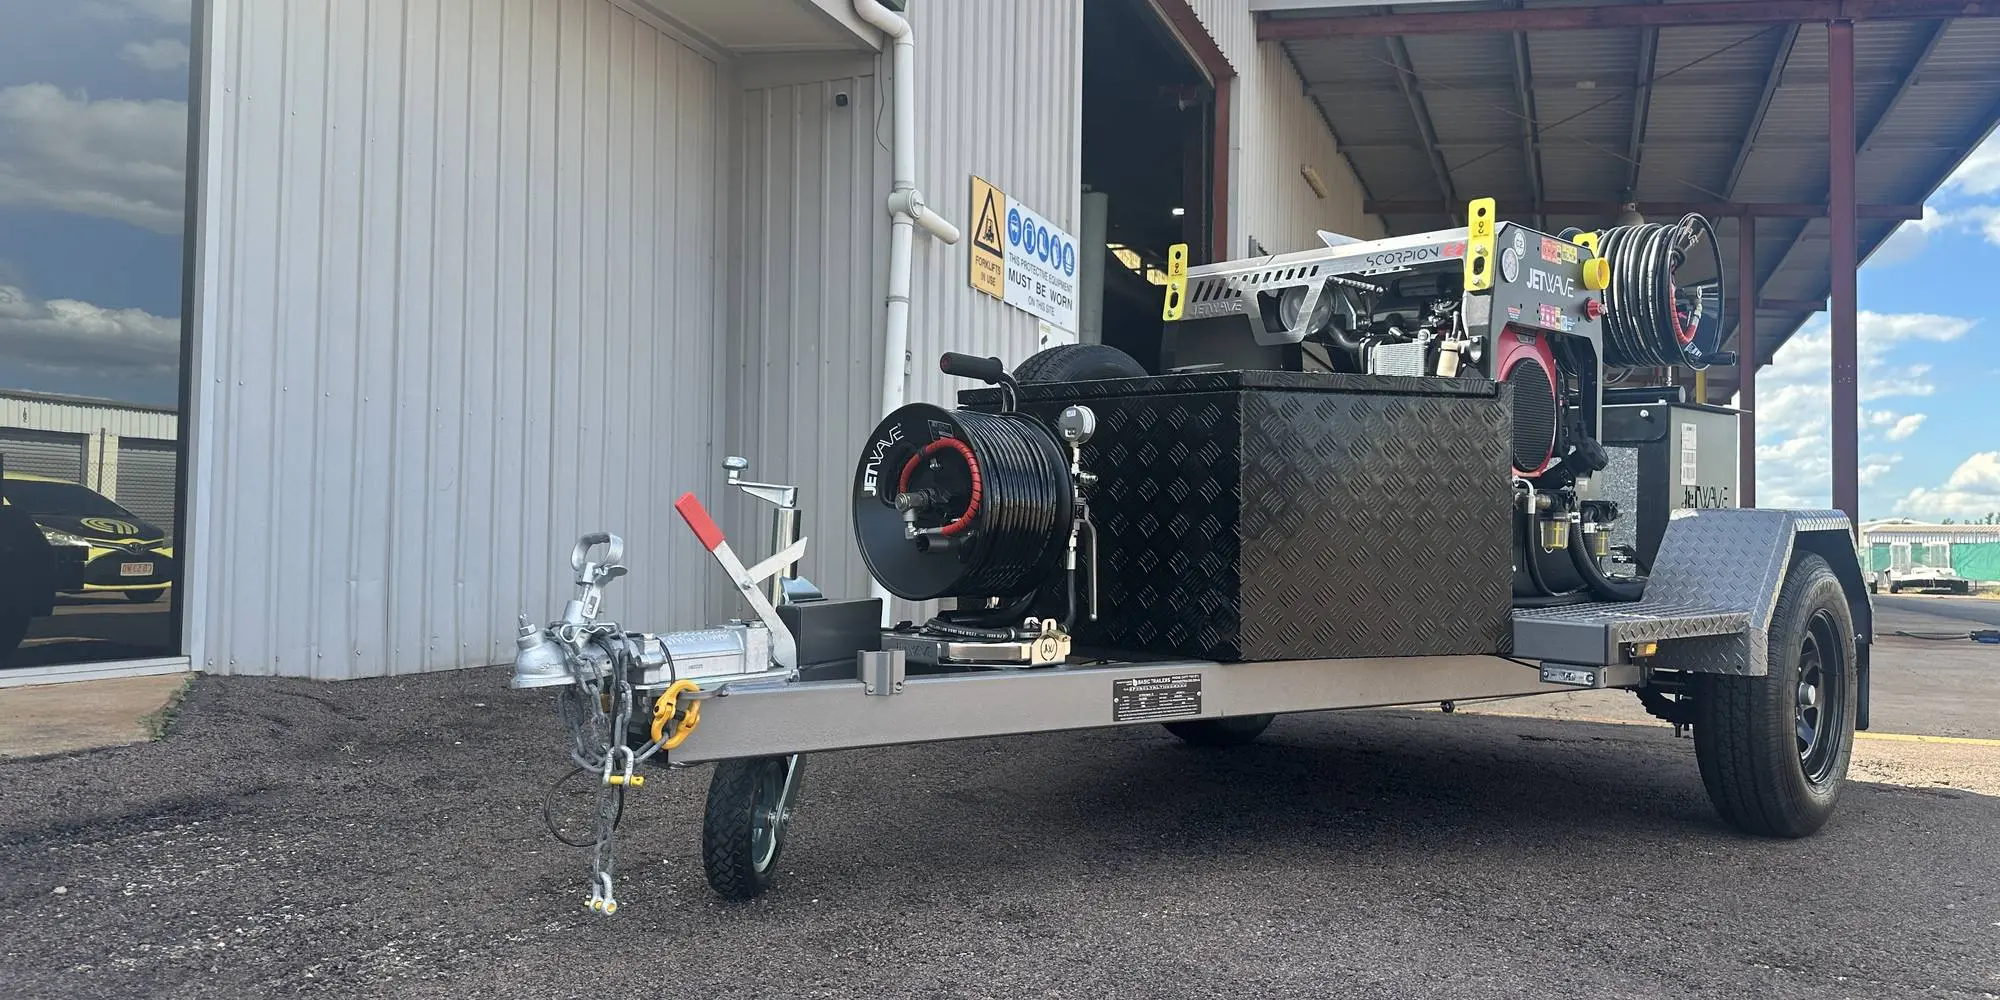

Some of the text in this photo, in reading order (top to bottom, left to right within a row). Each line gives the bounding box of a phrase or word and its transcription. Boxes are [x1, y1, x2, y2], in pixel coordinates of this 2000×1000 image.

[975, 255, 1001, 276] FORKLIFTS
[1366, 247, 1439, 267] SCORPION
[981, 271, 996, 287] IN USE
[1009, 252, 1073, 294] THIS PROTECTIVE EQUIPMENT
[1527, 267, 1574, 298] JETWAVE
[1008, 267, 1073, 311] MUST BE WORN
[1028, 295, 1055, 316] ON THIS SITE
[864, 425, 904, 496] JETWAVE
